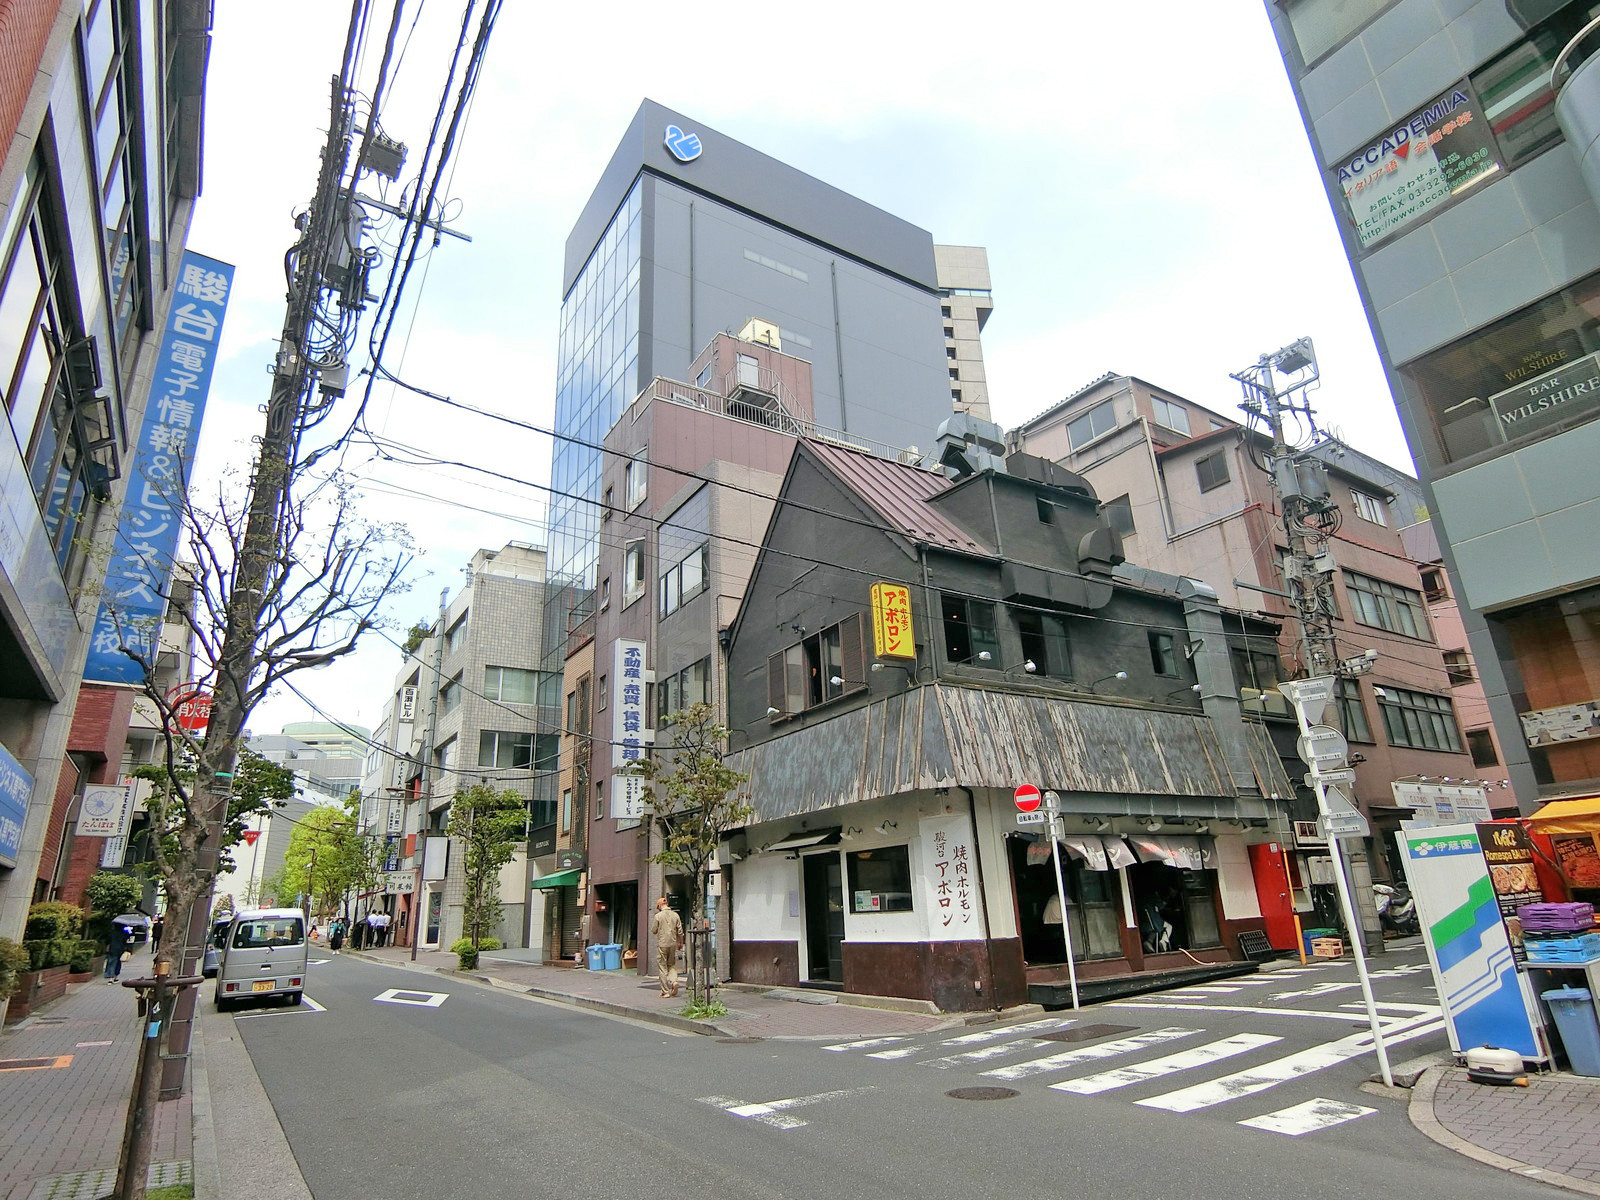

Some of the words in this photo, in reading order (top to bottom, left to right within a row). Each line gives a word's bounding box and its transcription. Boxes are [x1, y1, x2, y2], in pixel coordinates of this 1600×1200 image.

[1338, 90, 1469, 184] ACCADEMIA
[1344, 159, 1399, 198] イタリア語
[1358, 198, 1405, 232] TEL/FAX
[1505, 349, 1568, 381] WILSHIRE
[1523, 350, 1542, 362] BAR
[1501, 376, 1600, 424] WILSHIRE
[1529, 378, 1560, 396] BAR
[884, 591, 901, 652] アポロン
[621, 647, 641, 760] 不動産・売買・賃貸・管理
[934, 831, 947, 858] 駿河台
[1435, 839, 1473, 852] 伊藤園
[935, 861, 953, 927] アポロン
[953, 845, 971, 924] 焼肉ホルモン
